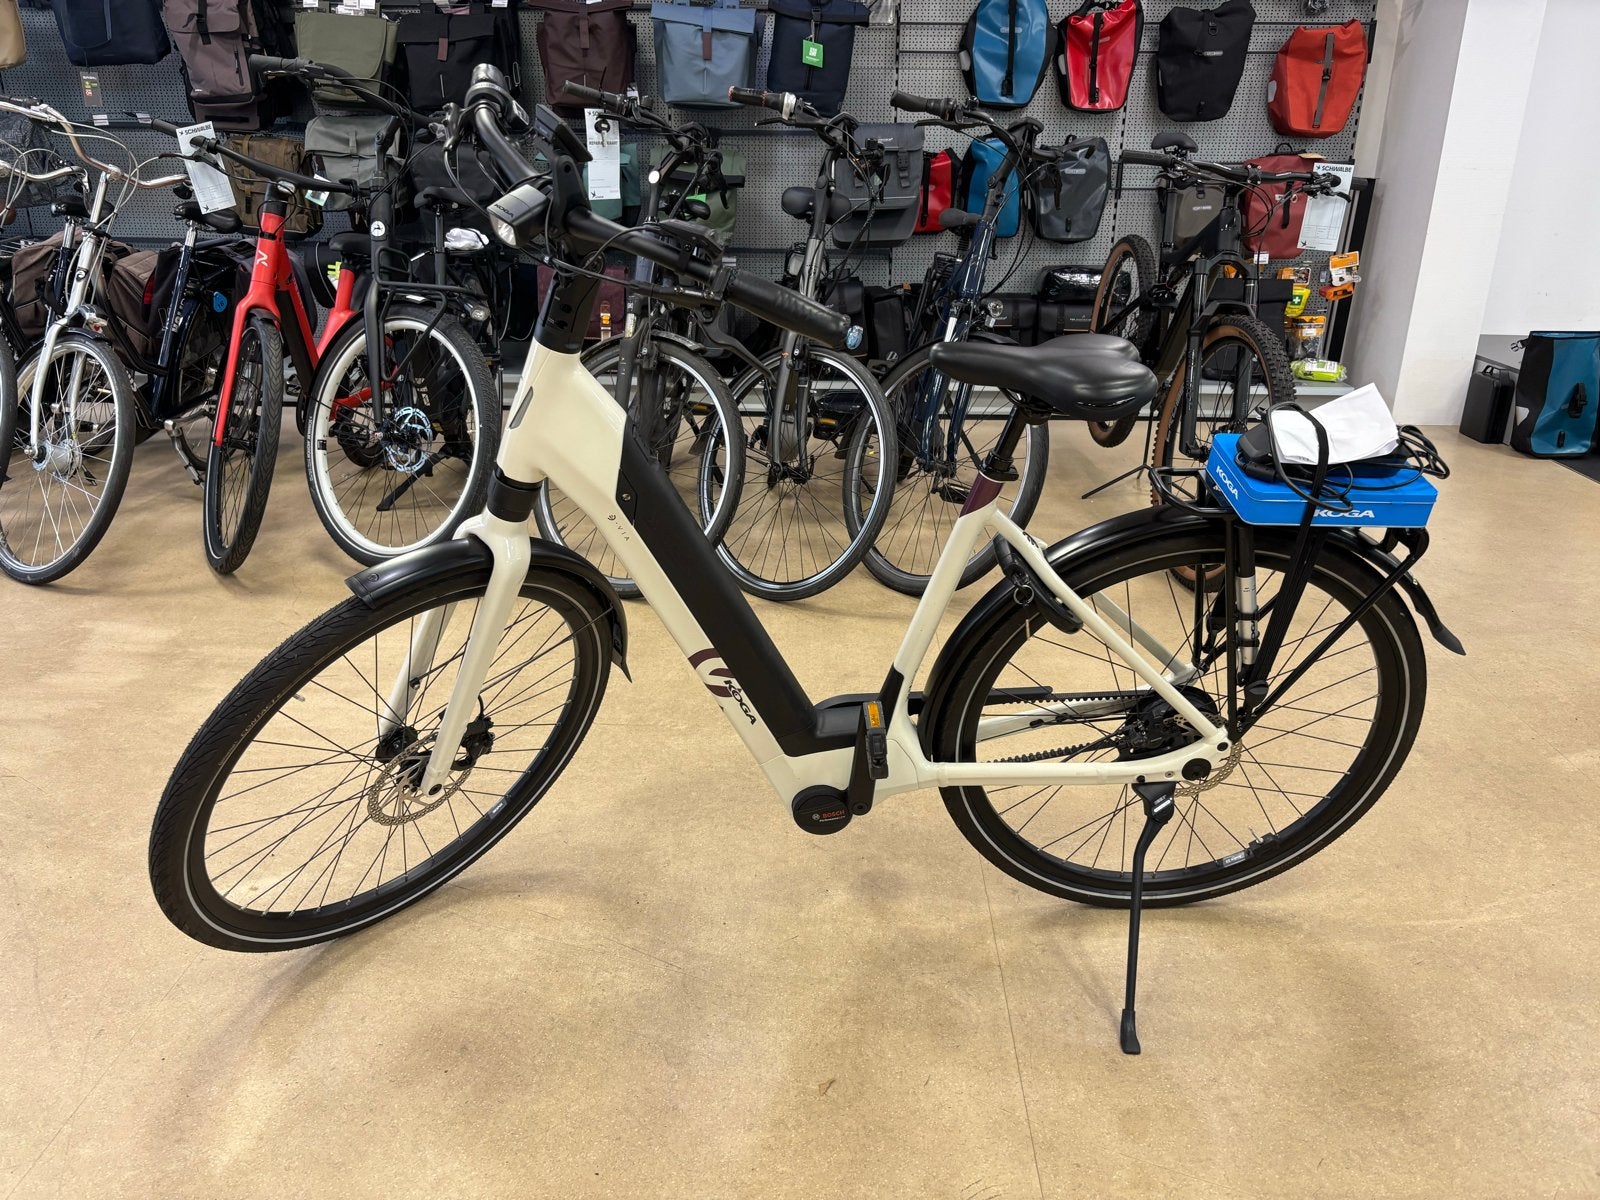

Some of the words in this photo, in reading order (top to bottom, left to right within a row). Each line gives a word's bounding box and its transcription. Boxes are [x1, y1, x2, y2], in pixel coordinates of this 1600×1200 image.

[1322, 165, 1353, 173] SCHWALBE
[494, 203, 515, 218] KOGA
[1216, 465, 1239, 500] KOGA
[723, 679, 757, 725] KOGA
[822, 809, 845, 819] BOSCH
